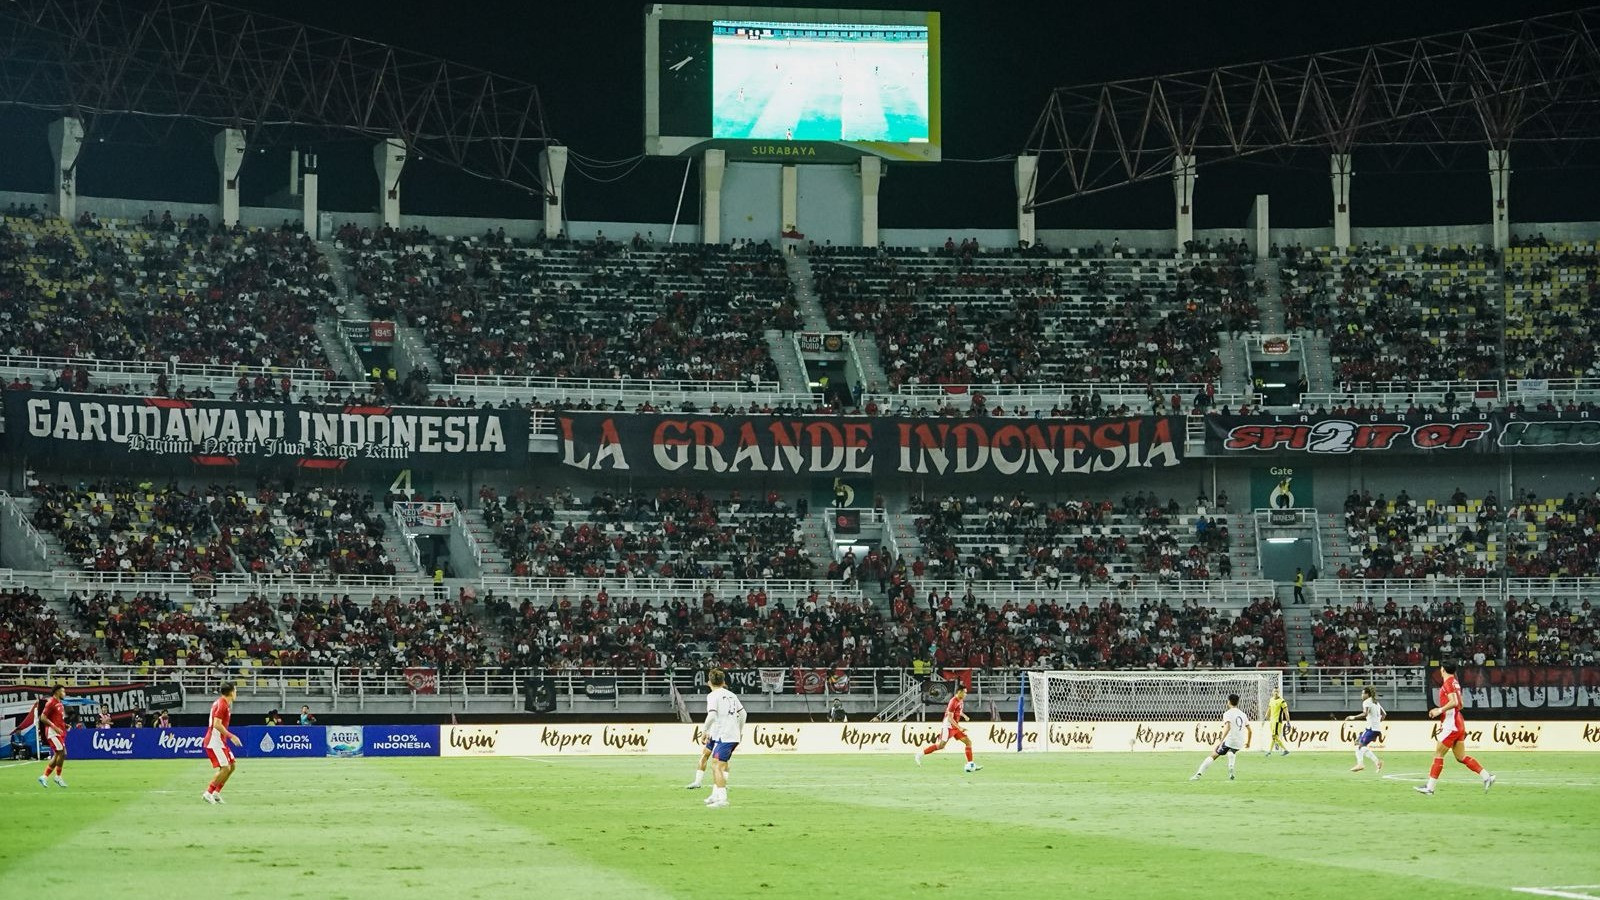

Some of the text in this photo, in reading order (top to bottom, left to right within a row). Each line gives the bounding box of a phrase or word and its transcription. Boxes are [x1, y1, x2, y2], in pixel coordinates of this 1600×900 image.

[752, 146, 816, 155] SURABAYA
[27, 399, 507, 453] GARUDAWANI INDONESIA
[1411, 422, 1492, 449] OF
[128, 434, 194, 454] Bagimu
[200, 437, 257, 457] Negeri
[559, 416, 1181, 476] LA GRANDE INDONESIA
[1270, 466, 1293, 476] Gate
[390, 469, 415, 502] 4
[1235, 716, 1243, 731] 9
[158, 730, 204, 753] kopra
[279, 735, 309, 743] 100%
[330, 733, 360, 744] AQUA
[387, 734, 418, 742] 100%
